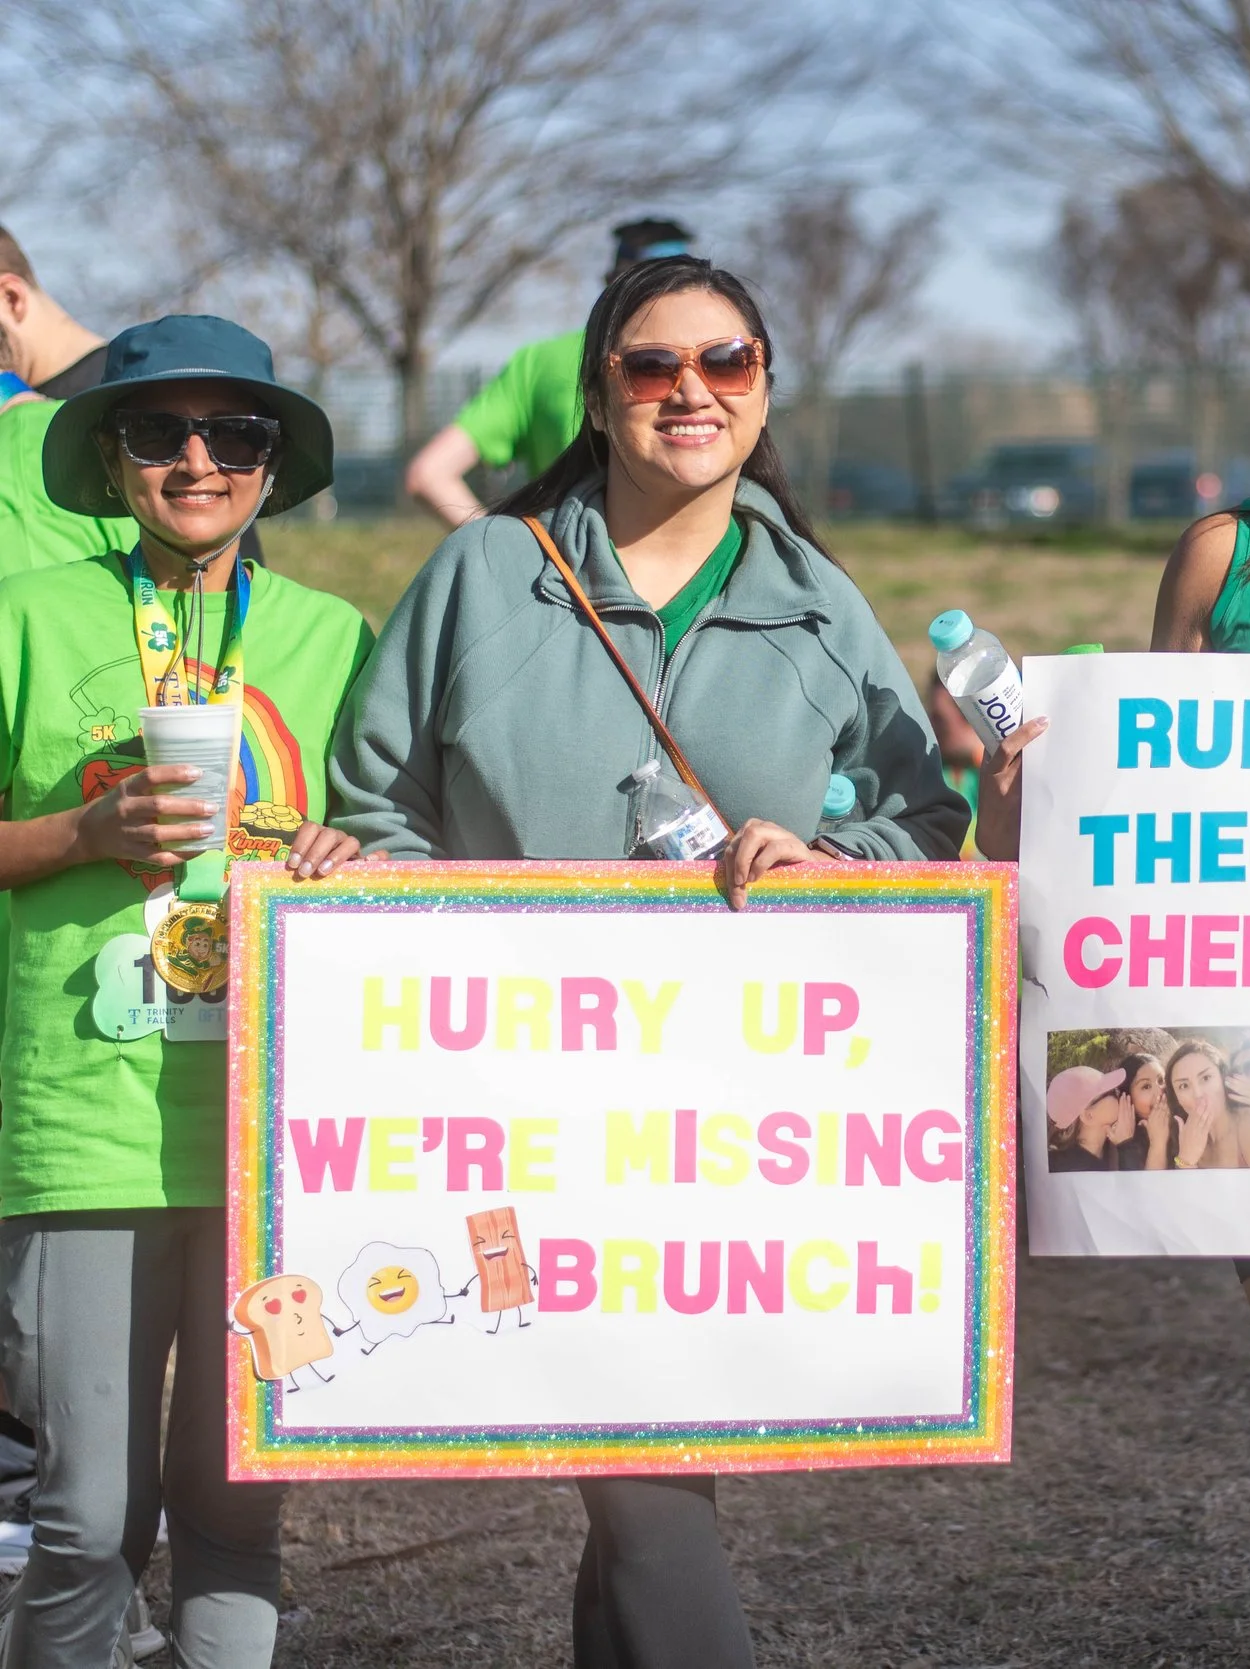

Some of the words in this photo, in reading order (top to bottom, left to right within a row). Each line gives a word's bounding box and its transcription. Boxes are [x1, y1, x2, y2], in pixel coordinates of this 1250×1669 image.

[140, 582, 154, 606] RUN
[155, 630, 169, 647] 5K
[91, 724, 116, 741] 5K
[147, 1007, 184, 1016] TRINITY
[147, 1016, 177, 1025] FALLS
[361, 976, 684, 1053] HURRY
[741, 981, 872, 1069] UP,
[288, 1116, 560, 1193] WE'RE
[604, 1109, 964, 1186] MISSING
